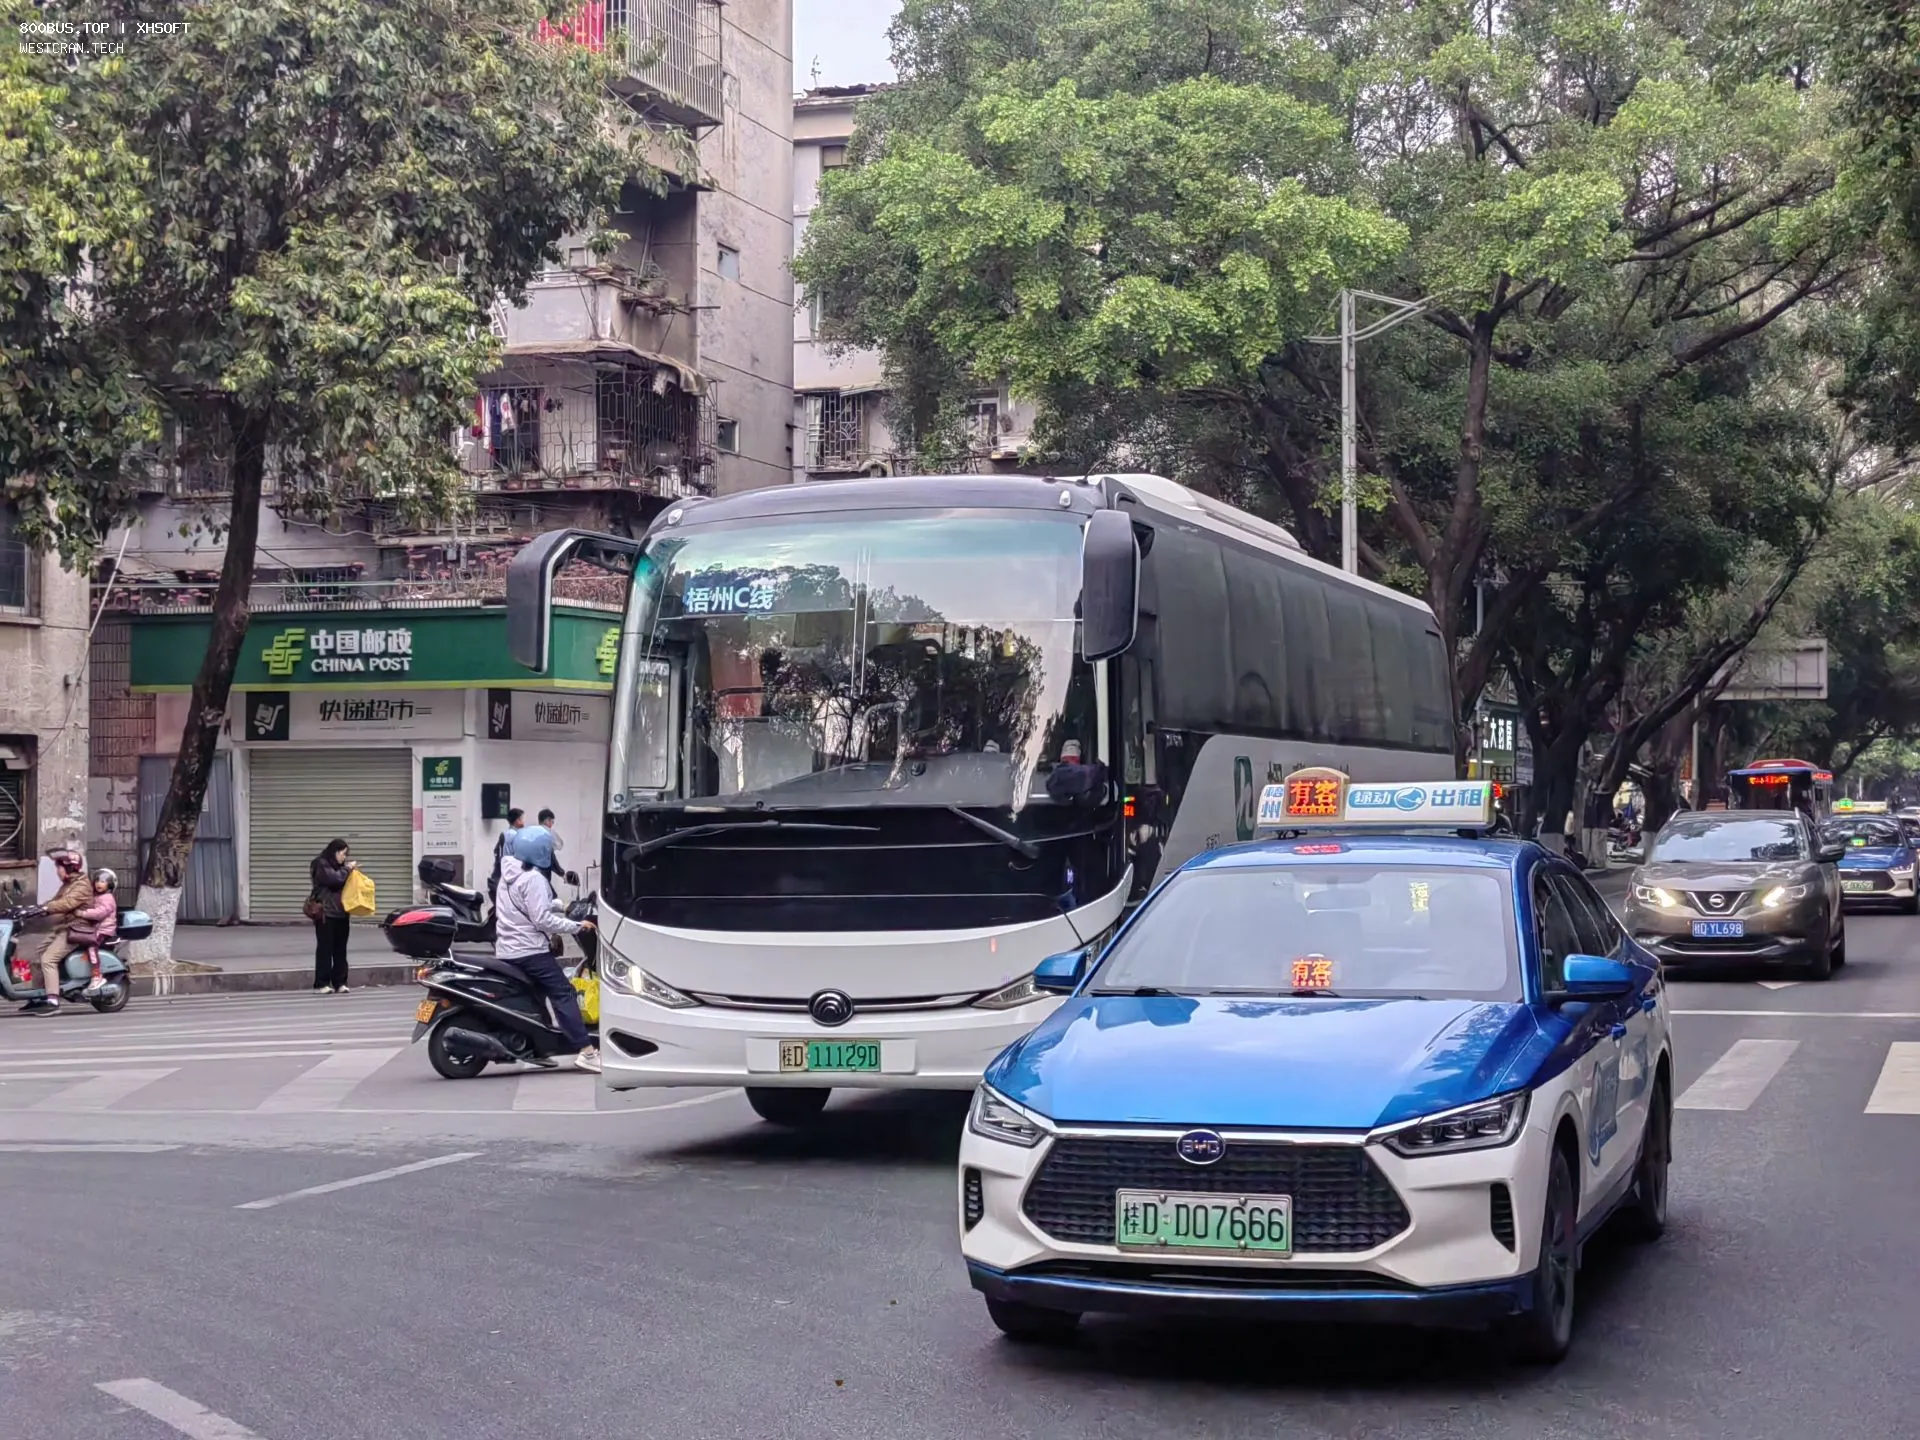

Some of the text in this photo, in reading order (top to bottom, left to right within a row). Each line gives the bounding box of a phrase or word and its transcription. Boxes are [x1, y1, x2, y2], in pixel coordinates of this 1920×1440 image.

[686, 585, 775, 613] 梧州C线
[310, 627, 412, 656] 中国邮政
[310, 657, 412, 672] CHINA POST
[319, 698, 413, 722] 快递超市
[1290, 779, 1338, 806] 有客
[1431, 788, 1483, 807] 出租
[1291, 959, 1332, 981] 有客
